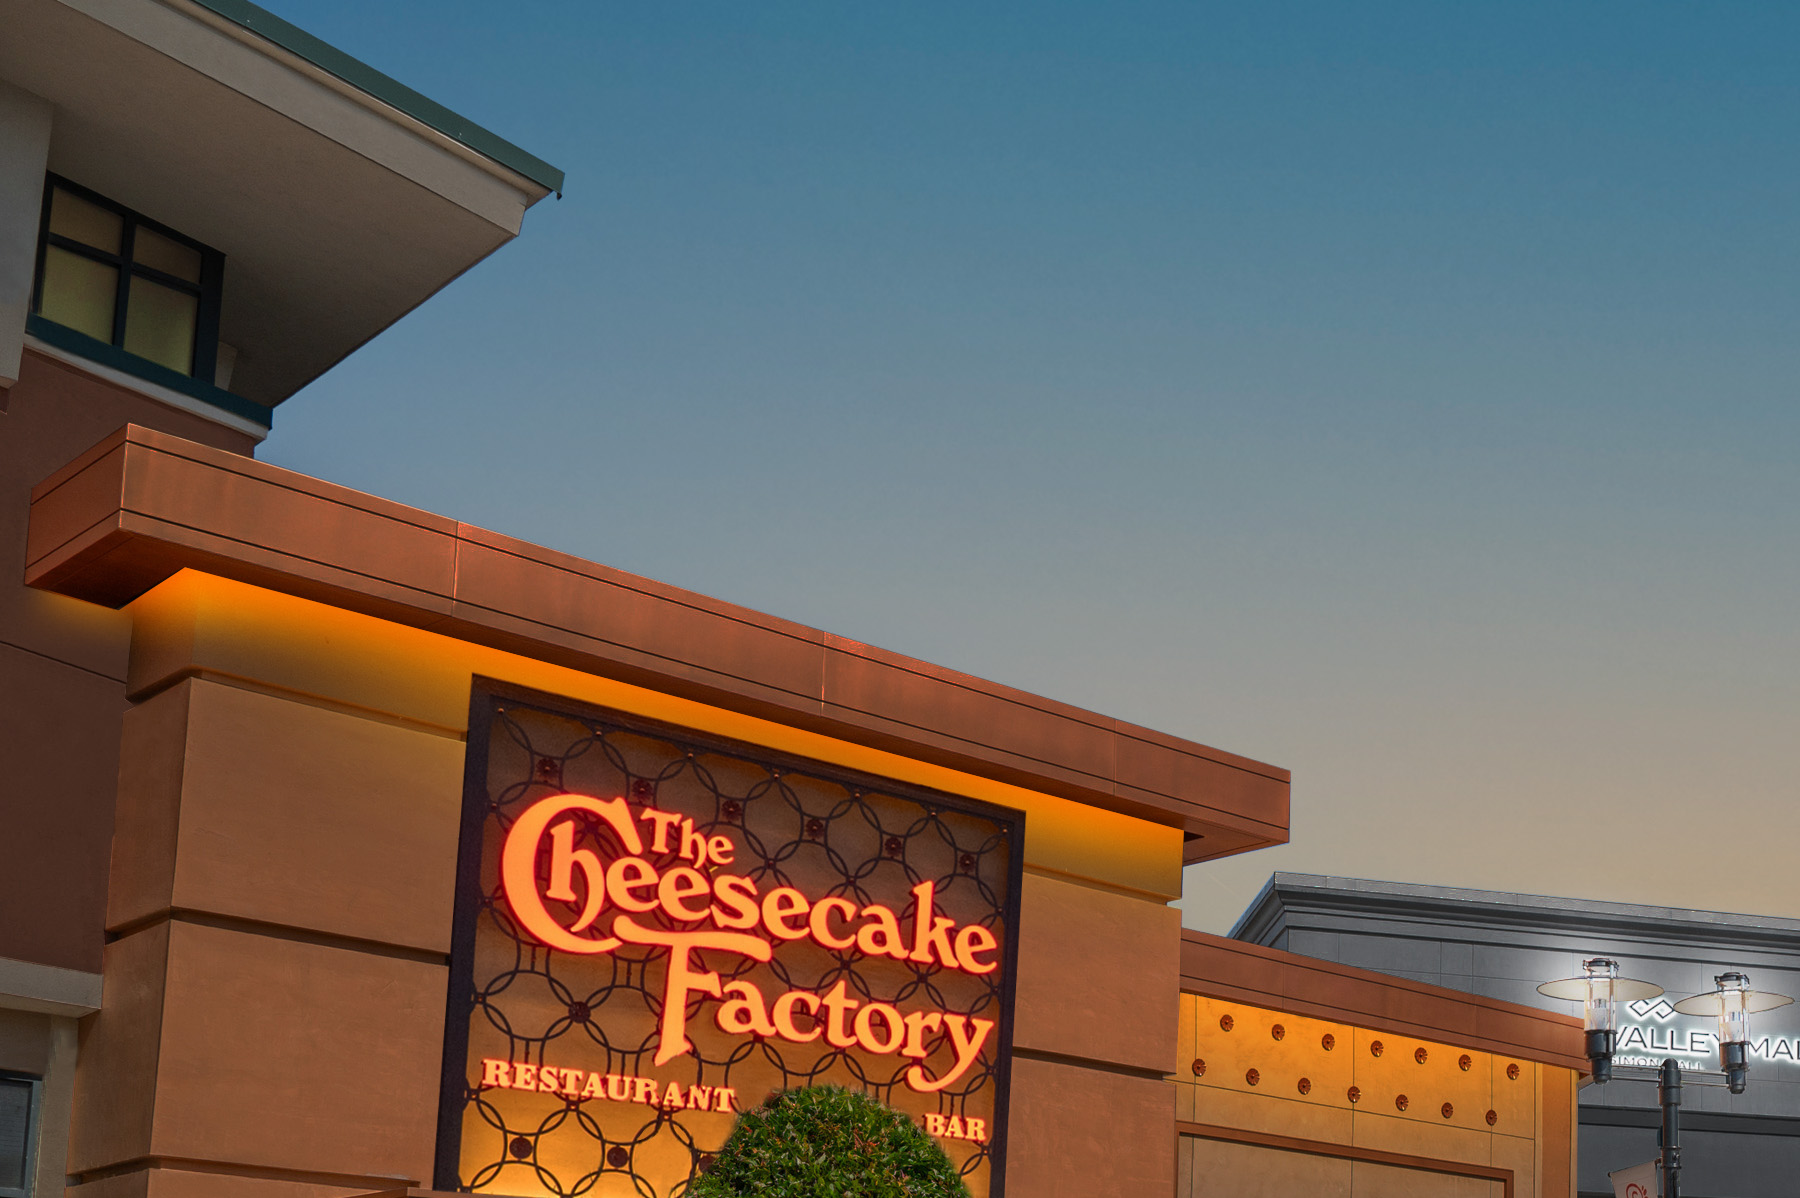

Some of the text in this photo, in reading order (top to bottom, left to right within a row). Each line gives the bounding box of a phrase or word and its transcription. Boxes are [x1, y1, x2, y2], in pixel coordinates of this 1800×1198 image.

[502, 794, 998, 974] Cheesecake
[640, 807, 734, 867] The
[612, 914, 994, 1092] Factory
[481, 1058, 987, 1142] RESTAURANT BAR
